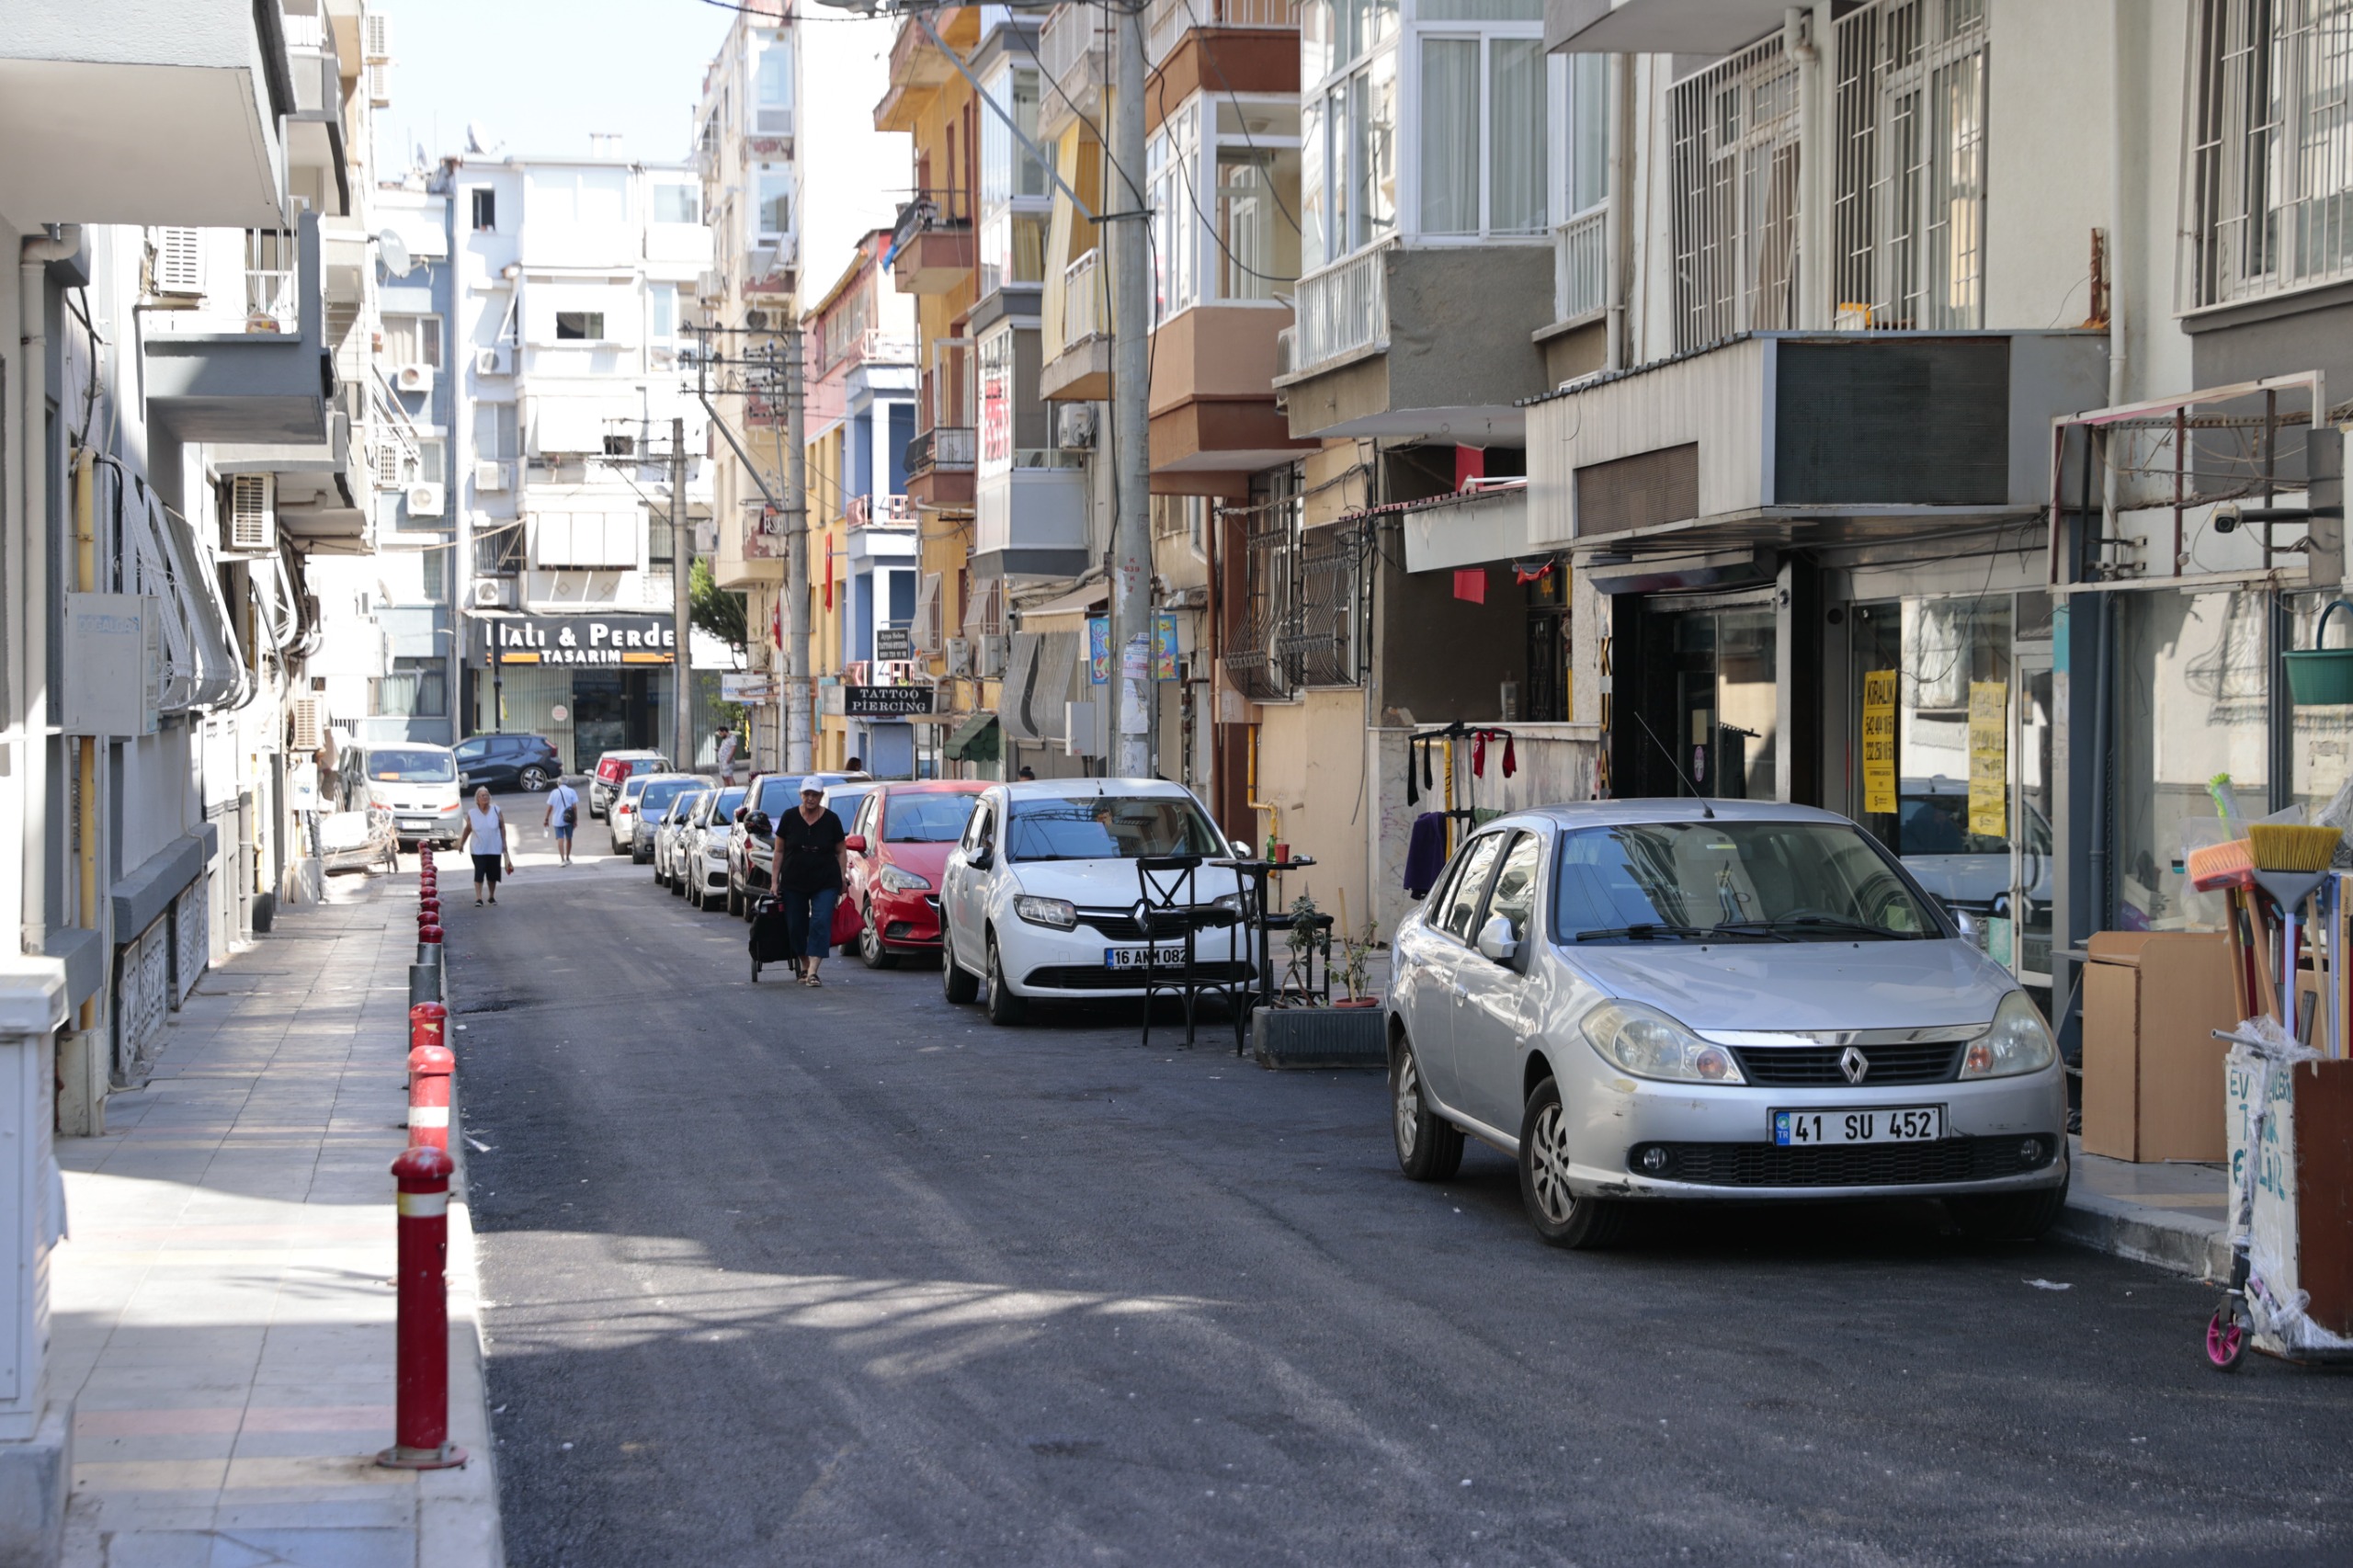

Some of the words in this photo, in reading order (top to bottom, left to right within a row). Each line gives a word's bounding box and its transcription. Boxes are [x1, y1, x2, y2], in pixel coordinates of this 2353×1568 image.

[559, 627, 577, 647] &
[540, 649, 621, 664] TASARIM
[859, 688, 919, 699] TATTOO
[852, 699, 926, 711] PİERCİNG
[1115, 950, 1130, 964] 16
[2231, 1070, 2249, 1100] EV
[1795, 1116, 1822, 1142] 41
[1845, 1114, 1873, 1141] SU
[1890, 1111, 1931, 1139] 452
[1777, 1131, 1789, 1139] TR
